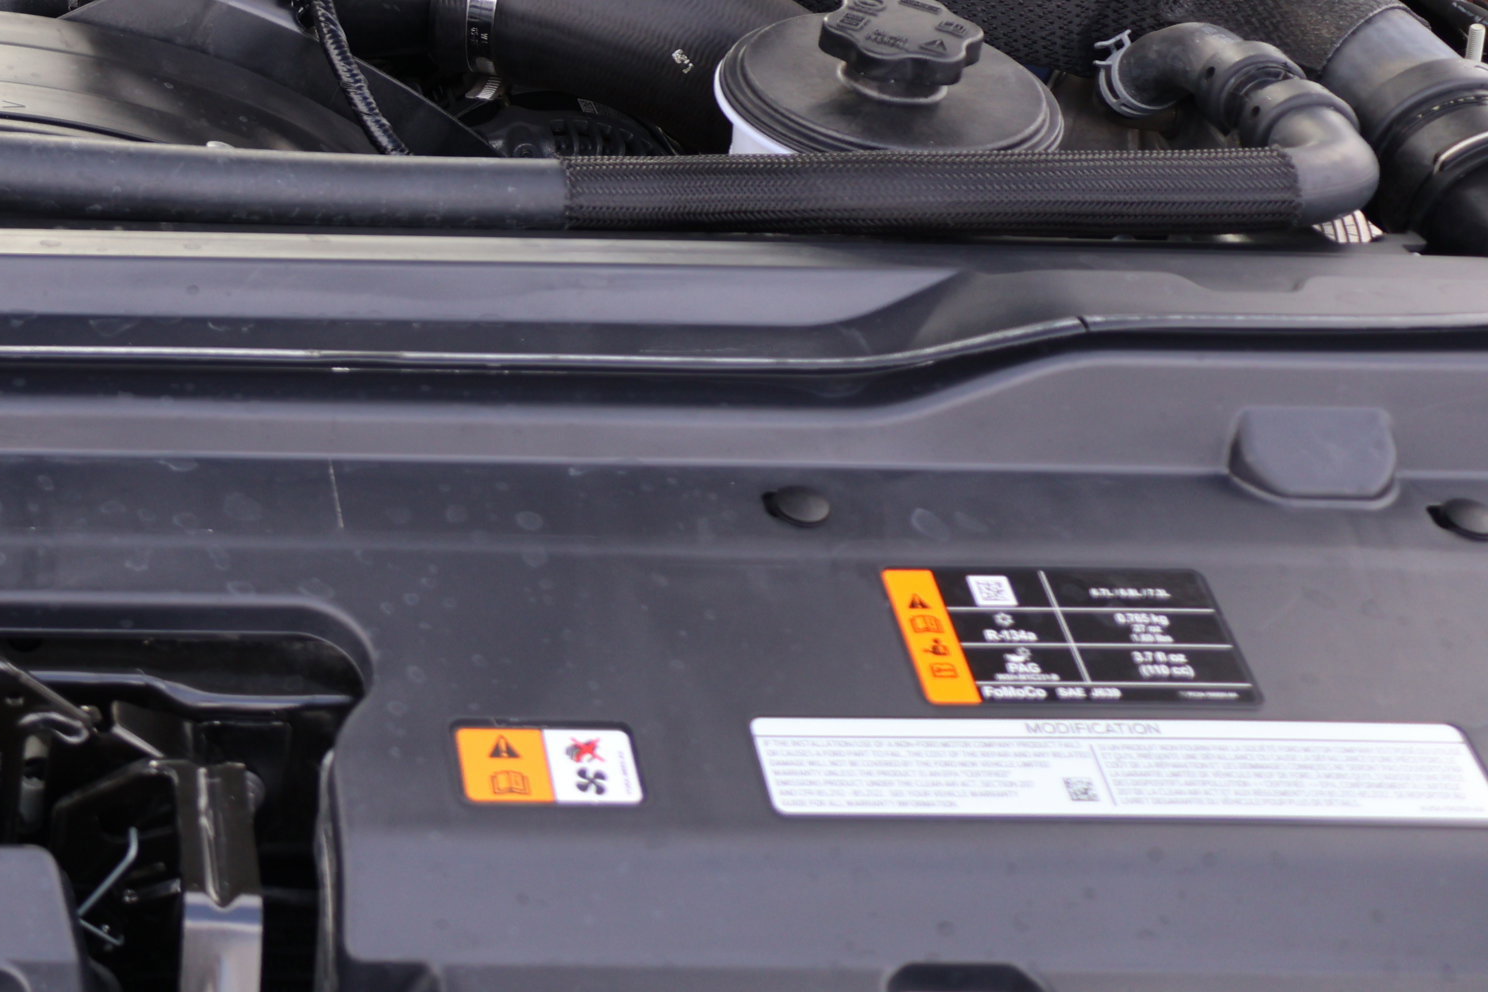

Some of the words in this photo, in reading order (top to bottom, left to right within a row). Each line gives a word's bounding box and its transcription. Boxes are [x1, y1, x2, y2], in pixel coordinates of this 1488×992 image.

[1151, 613, 1170, 627] kg
[983, 629, 1038, 641] R-134a
[1131, 651, 1153, 663] 3.7
[1005, 662, 1042, 674] PAG
[1138, 664, 1170, 679] (110
[1170, 665, 1196, 679] cc)
[982, 685, 1048, 700] FoMoCo
[1055, 686, 1088, 699] SAE
[1025, 722, 1162, 735] MODIFICATION
